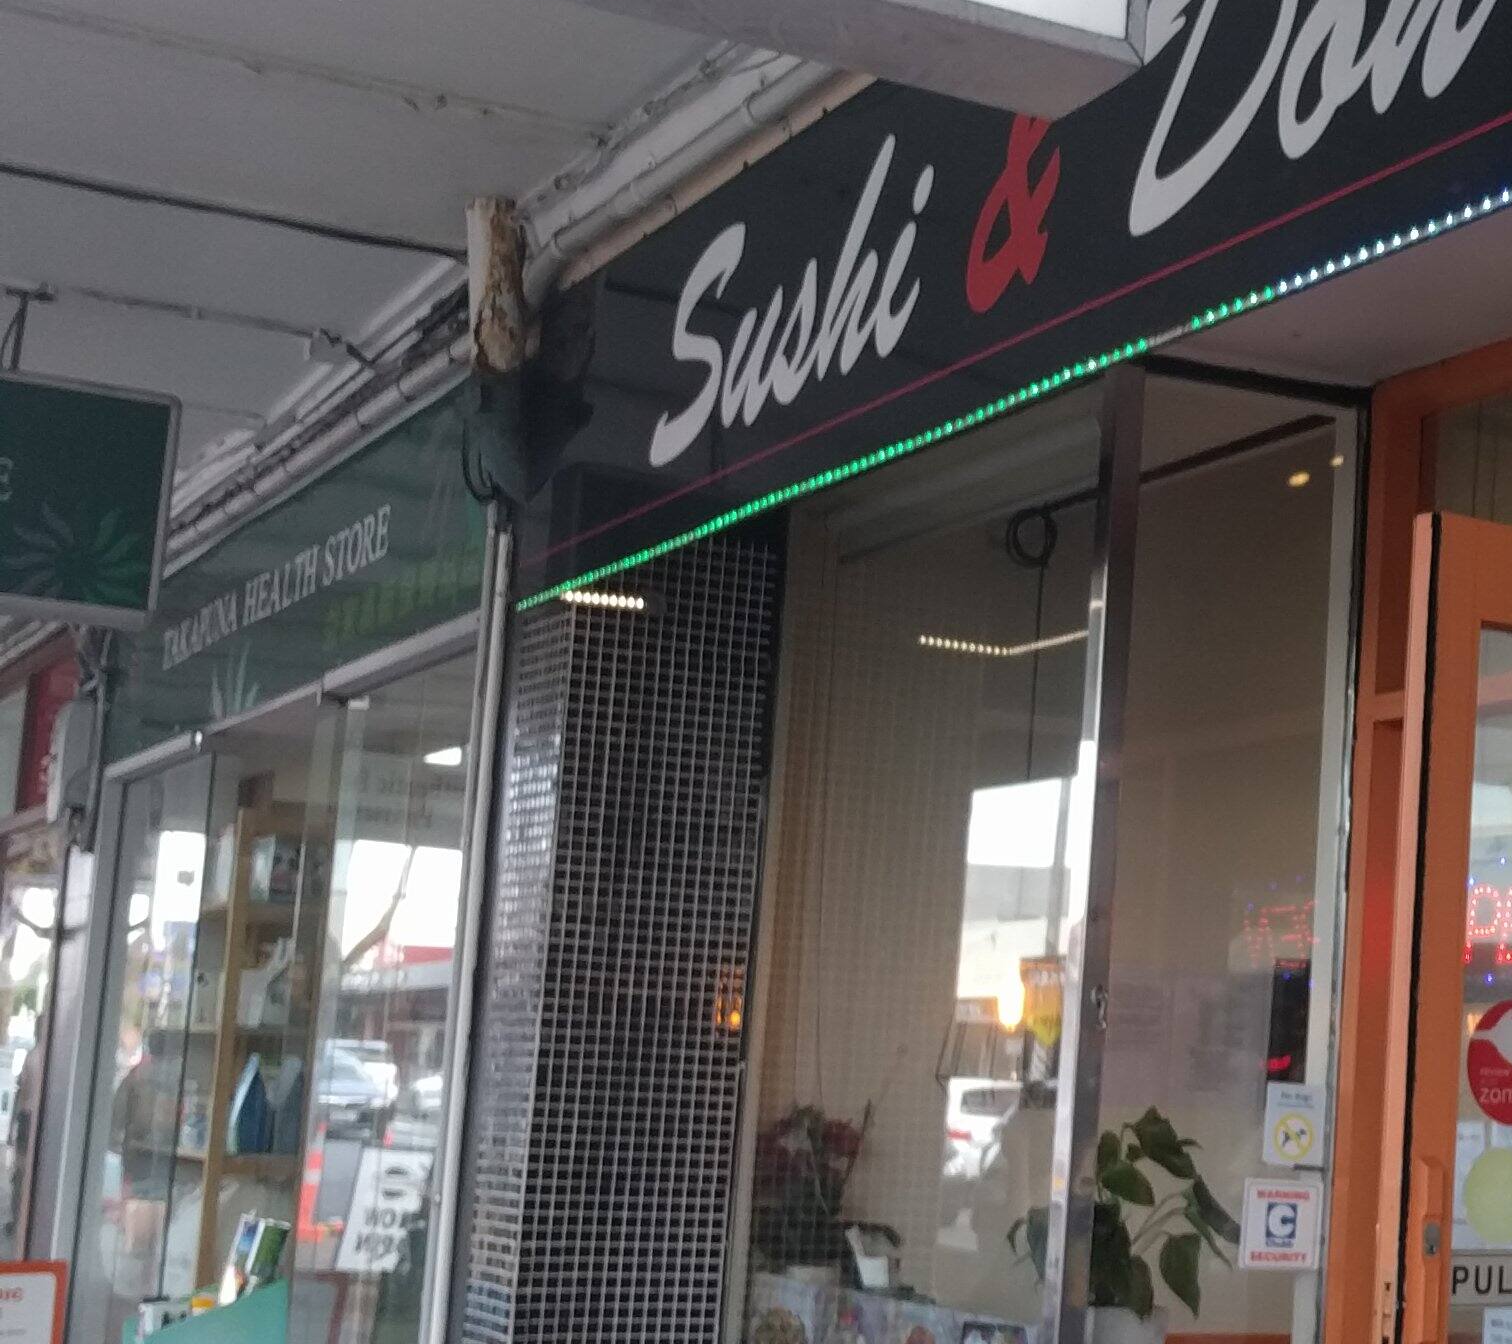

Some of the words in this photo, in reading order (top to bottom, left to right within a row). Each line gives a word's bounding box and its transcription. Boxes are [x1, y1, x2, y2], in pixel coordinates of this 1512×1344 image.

[649, 133, 935, 467] Sushi
[966, 116, 1061, 313] &
[242, 544, 322, 626] HEALTH
[322, 504, 391, 587] STORE
[1256, 1189, 1310, 1201] WARNING
